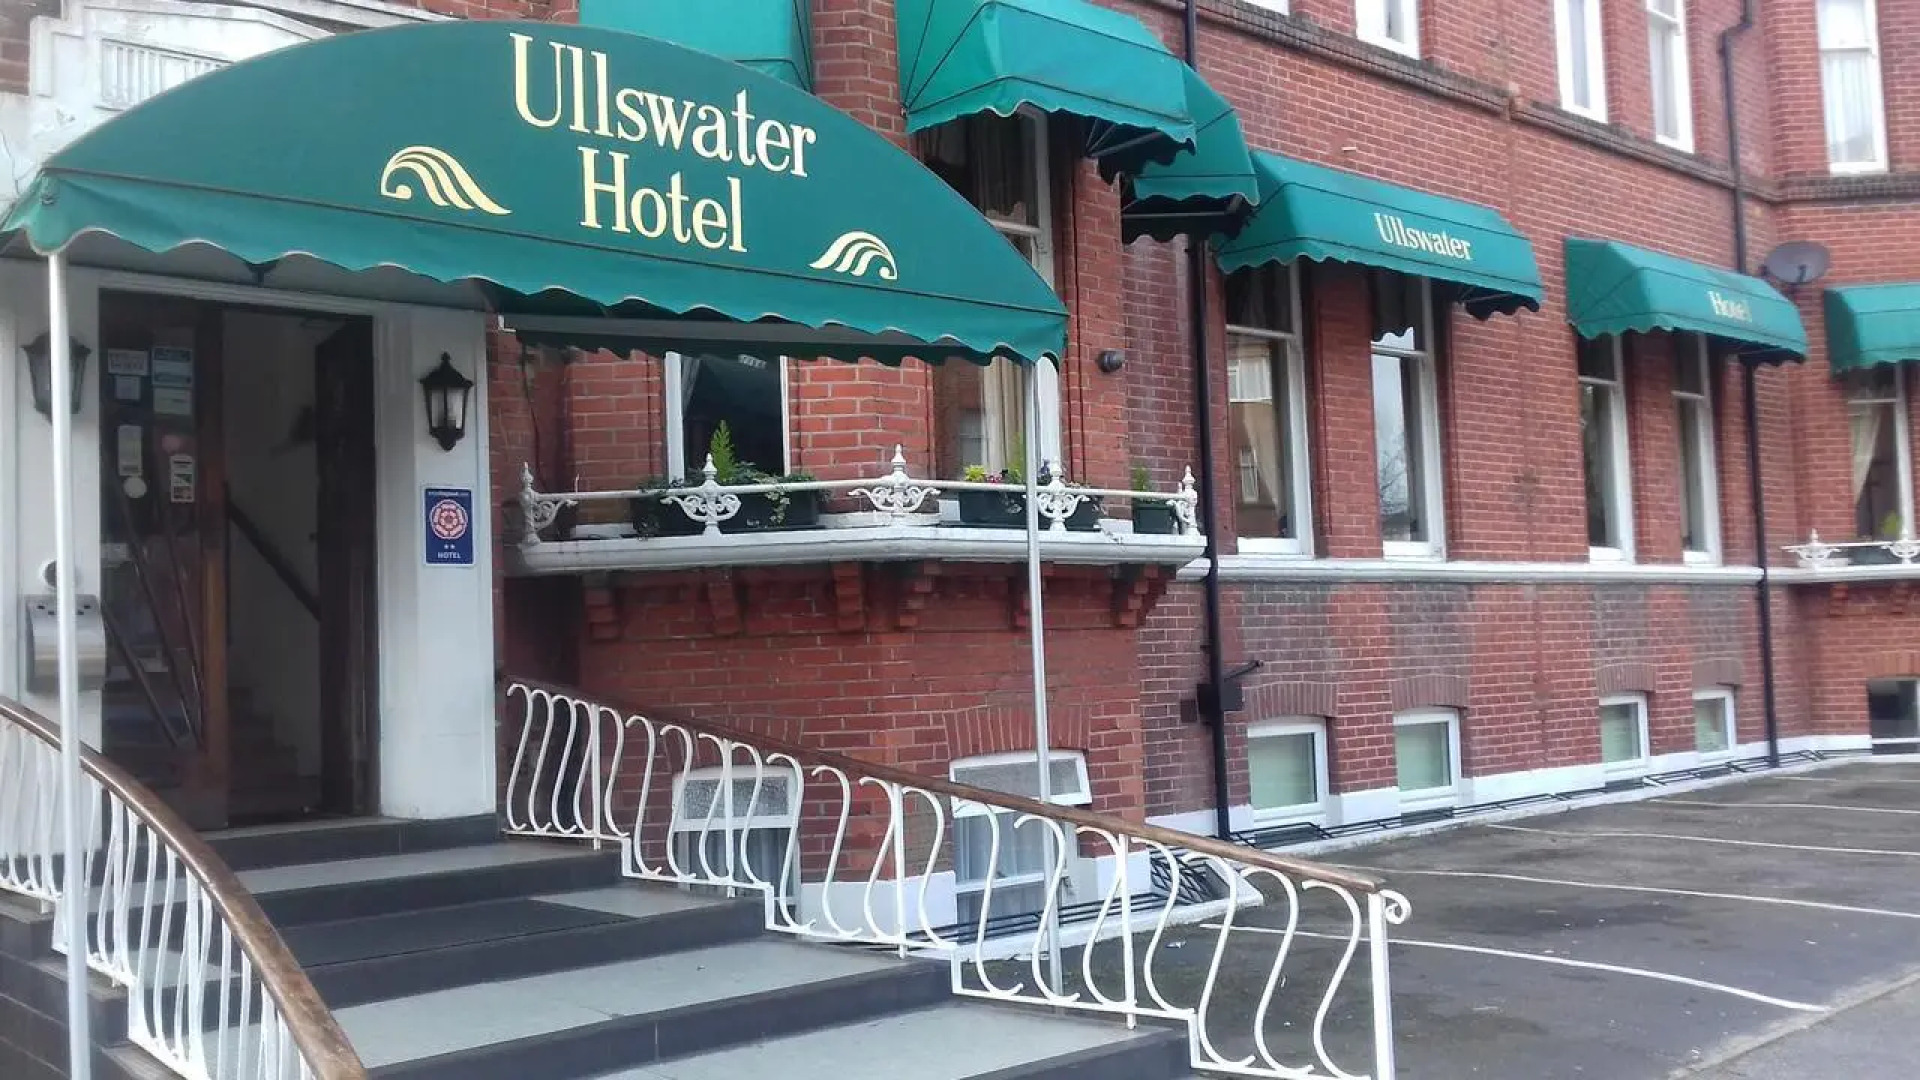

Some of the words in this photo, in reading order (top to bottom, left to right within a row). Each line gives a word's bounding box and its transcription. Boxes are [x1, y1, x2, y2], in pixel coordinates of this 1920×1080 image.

[509, 32, 816, 177] Ullswater
[578, 146, 747, 252] Hotel
[1373, 212, 1473, 260] Ullswater
[1706, 290, 1753, 322] Hotel
[437, 551, 461, 559] HOTEL
